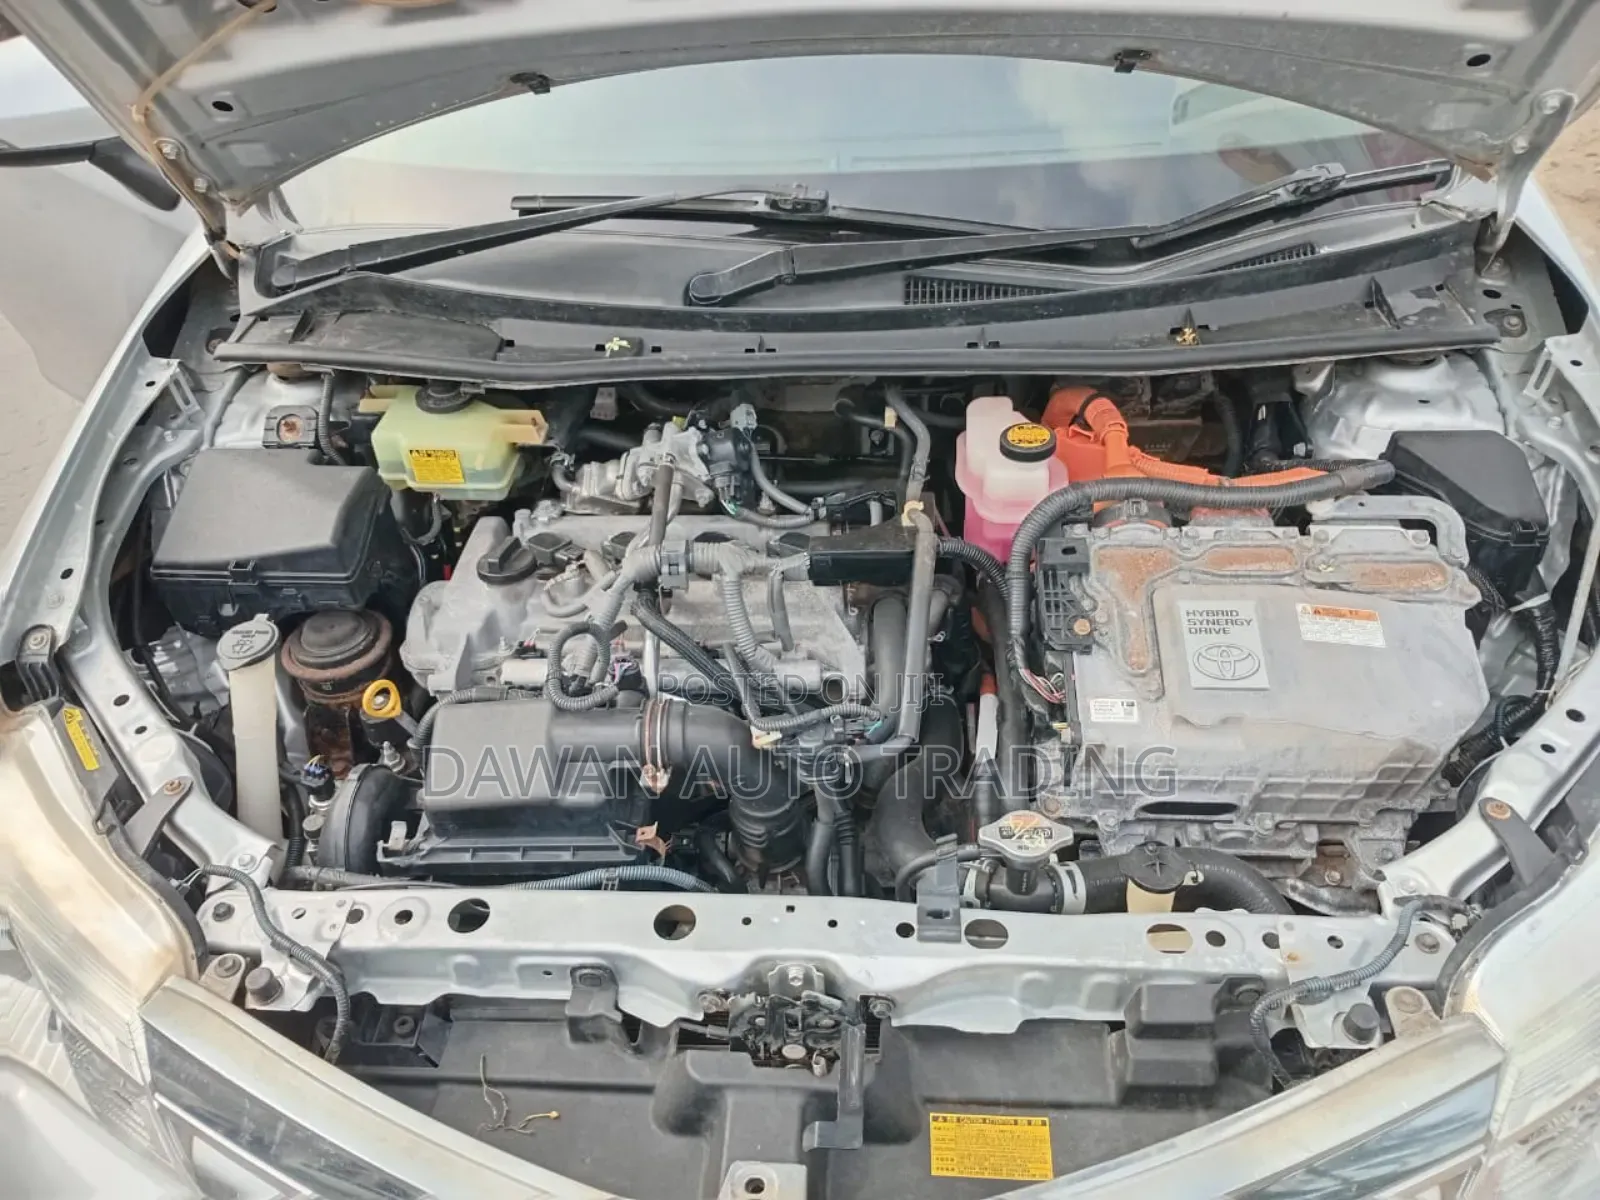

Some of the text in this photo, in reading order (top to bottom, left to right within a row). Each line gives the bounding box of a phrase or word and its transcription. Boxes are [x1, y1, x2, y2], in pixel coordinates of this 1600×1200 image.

[1185, 609, 1240, 617] HYBRID
[1187, 618, 1254, 626] SYNERGY
[1188, 627, 1231, 635] DRIVE
